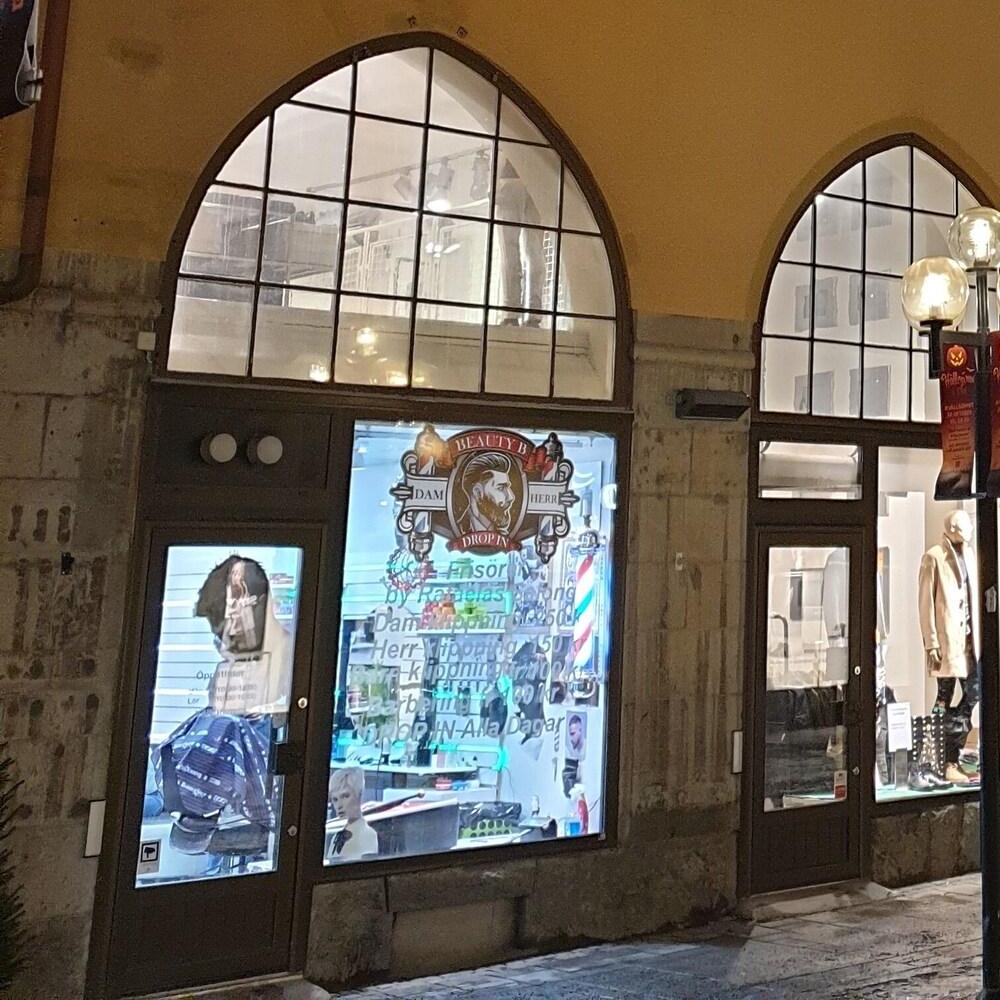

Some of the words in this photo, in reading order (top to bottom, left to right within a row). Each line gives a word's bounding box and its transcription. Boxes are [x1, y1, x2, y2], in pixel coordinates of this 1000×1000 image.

[455, 433, 517, 451] BEAUTY
[414, 489, 445, 501] DAM
[530, 492, 558, 503] HERR
[462, 533, 495, 548] DROP
[496, 534, 510, 547] IN
[384, 577, 410, 608] by
[508, 712, 566, 738] Dagar
